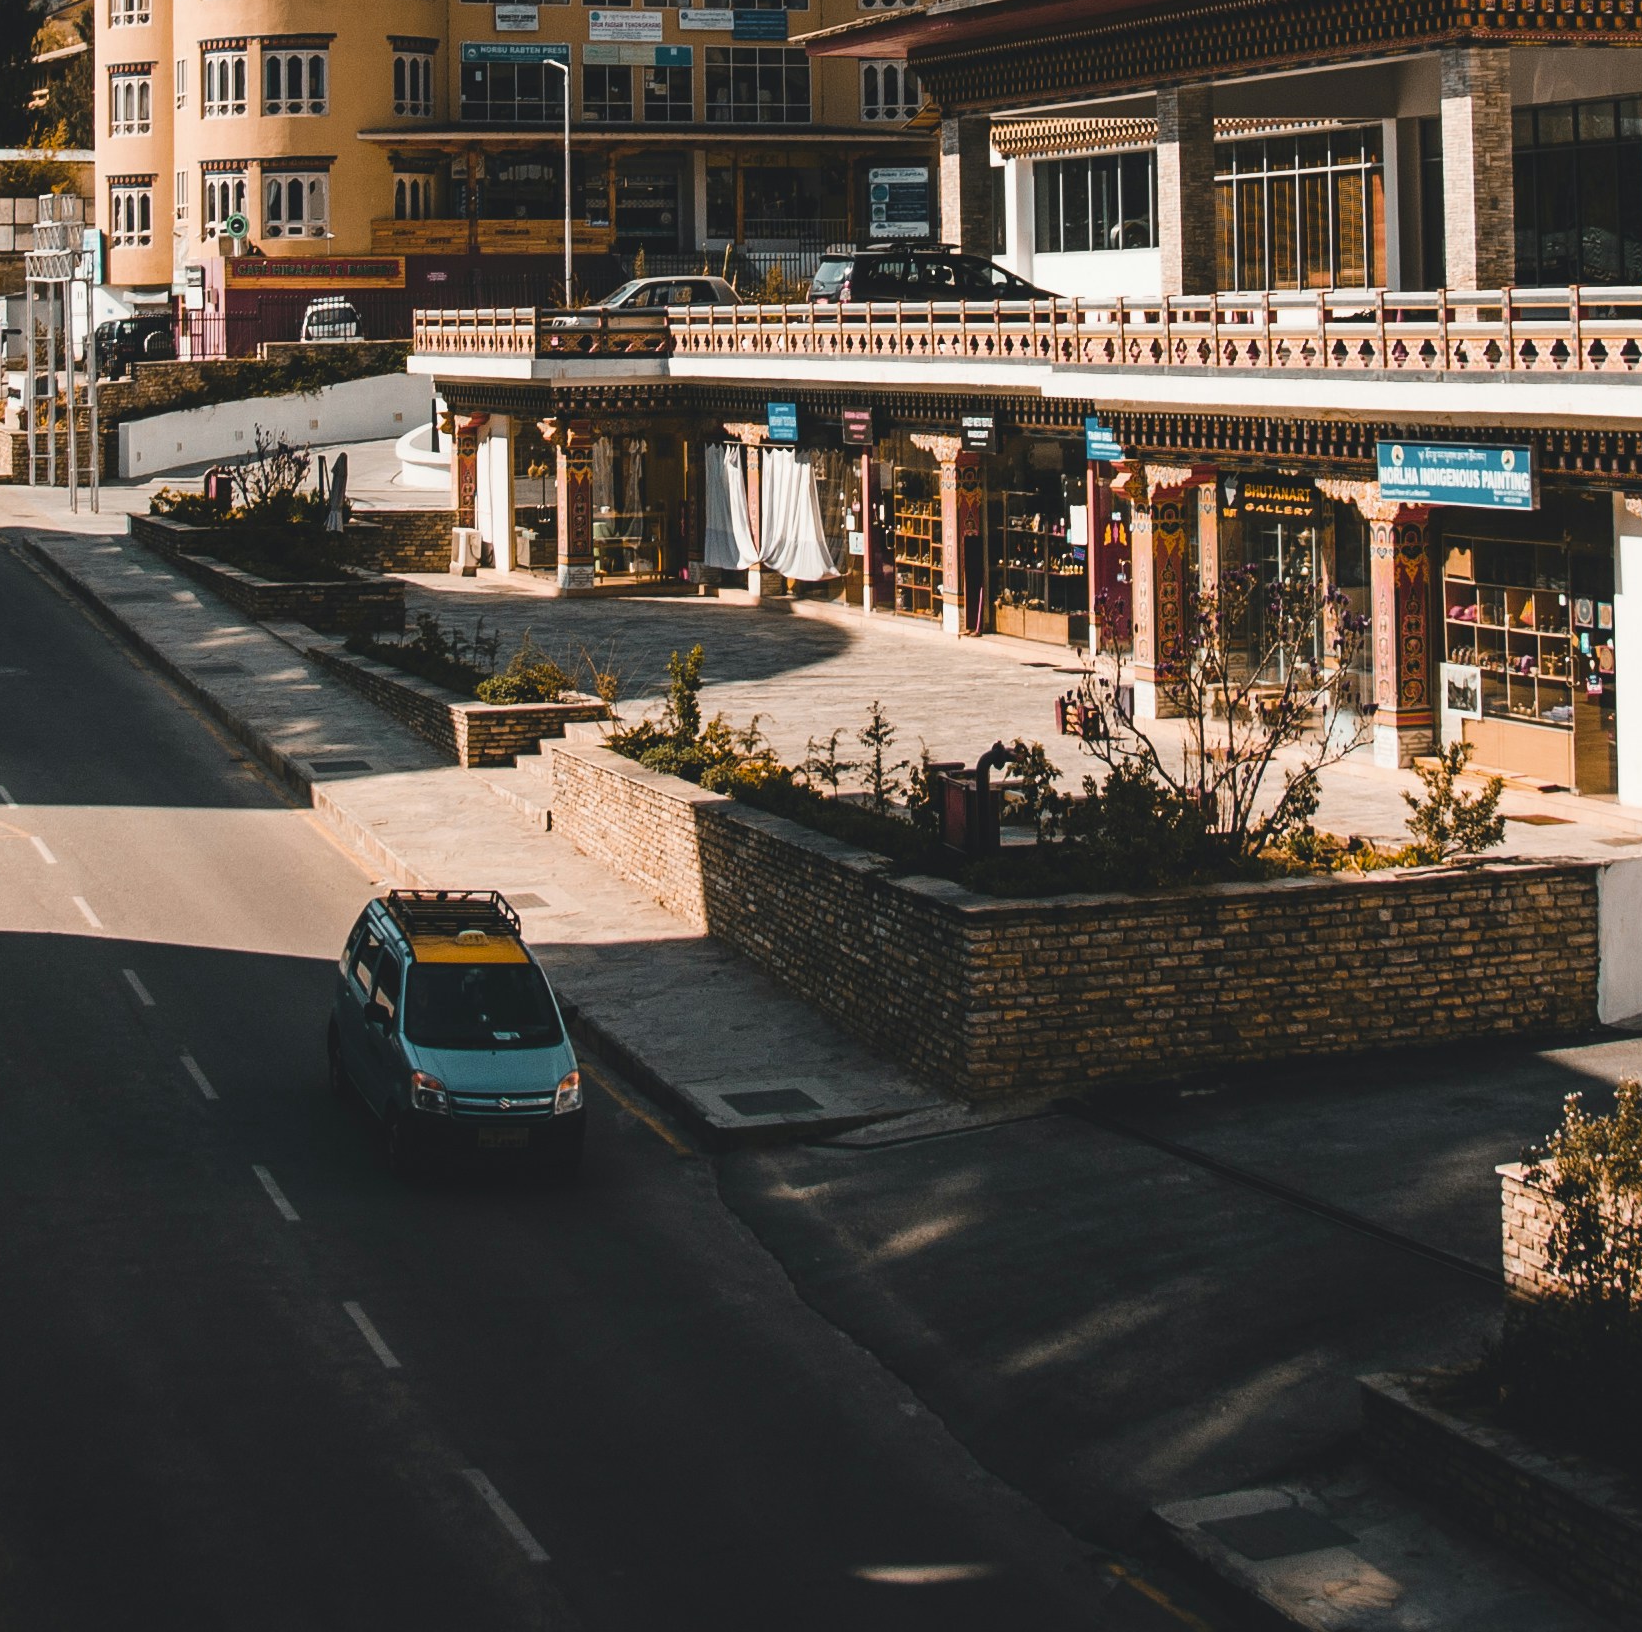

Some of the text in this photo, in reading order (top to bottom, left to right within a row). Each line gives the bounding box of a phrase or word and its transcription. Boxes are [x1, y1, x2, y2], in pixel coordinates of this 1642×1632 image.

[480, 46, 567, 55] NORBU RABTEN PRESS
[1380, 466, 1531, 492] NORLHA INDIGENOUS PAINTING
[1244, 502, 1314, 517] GALLERY
